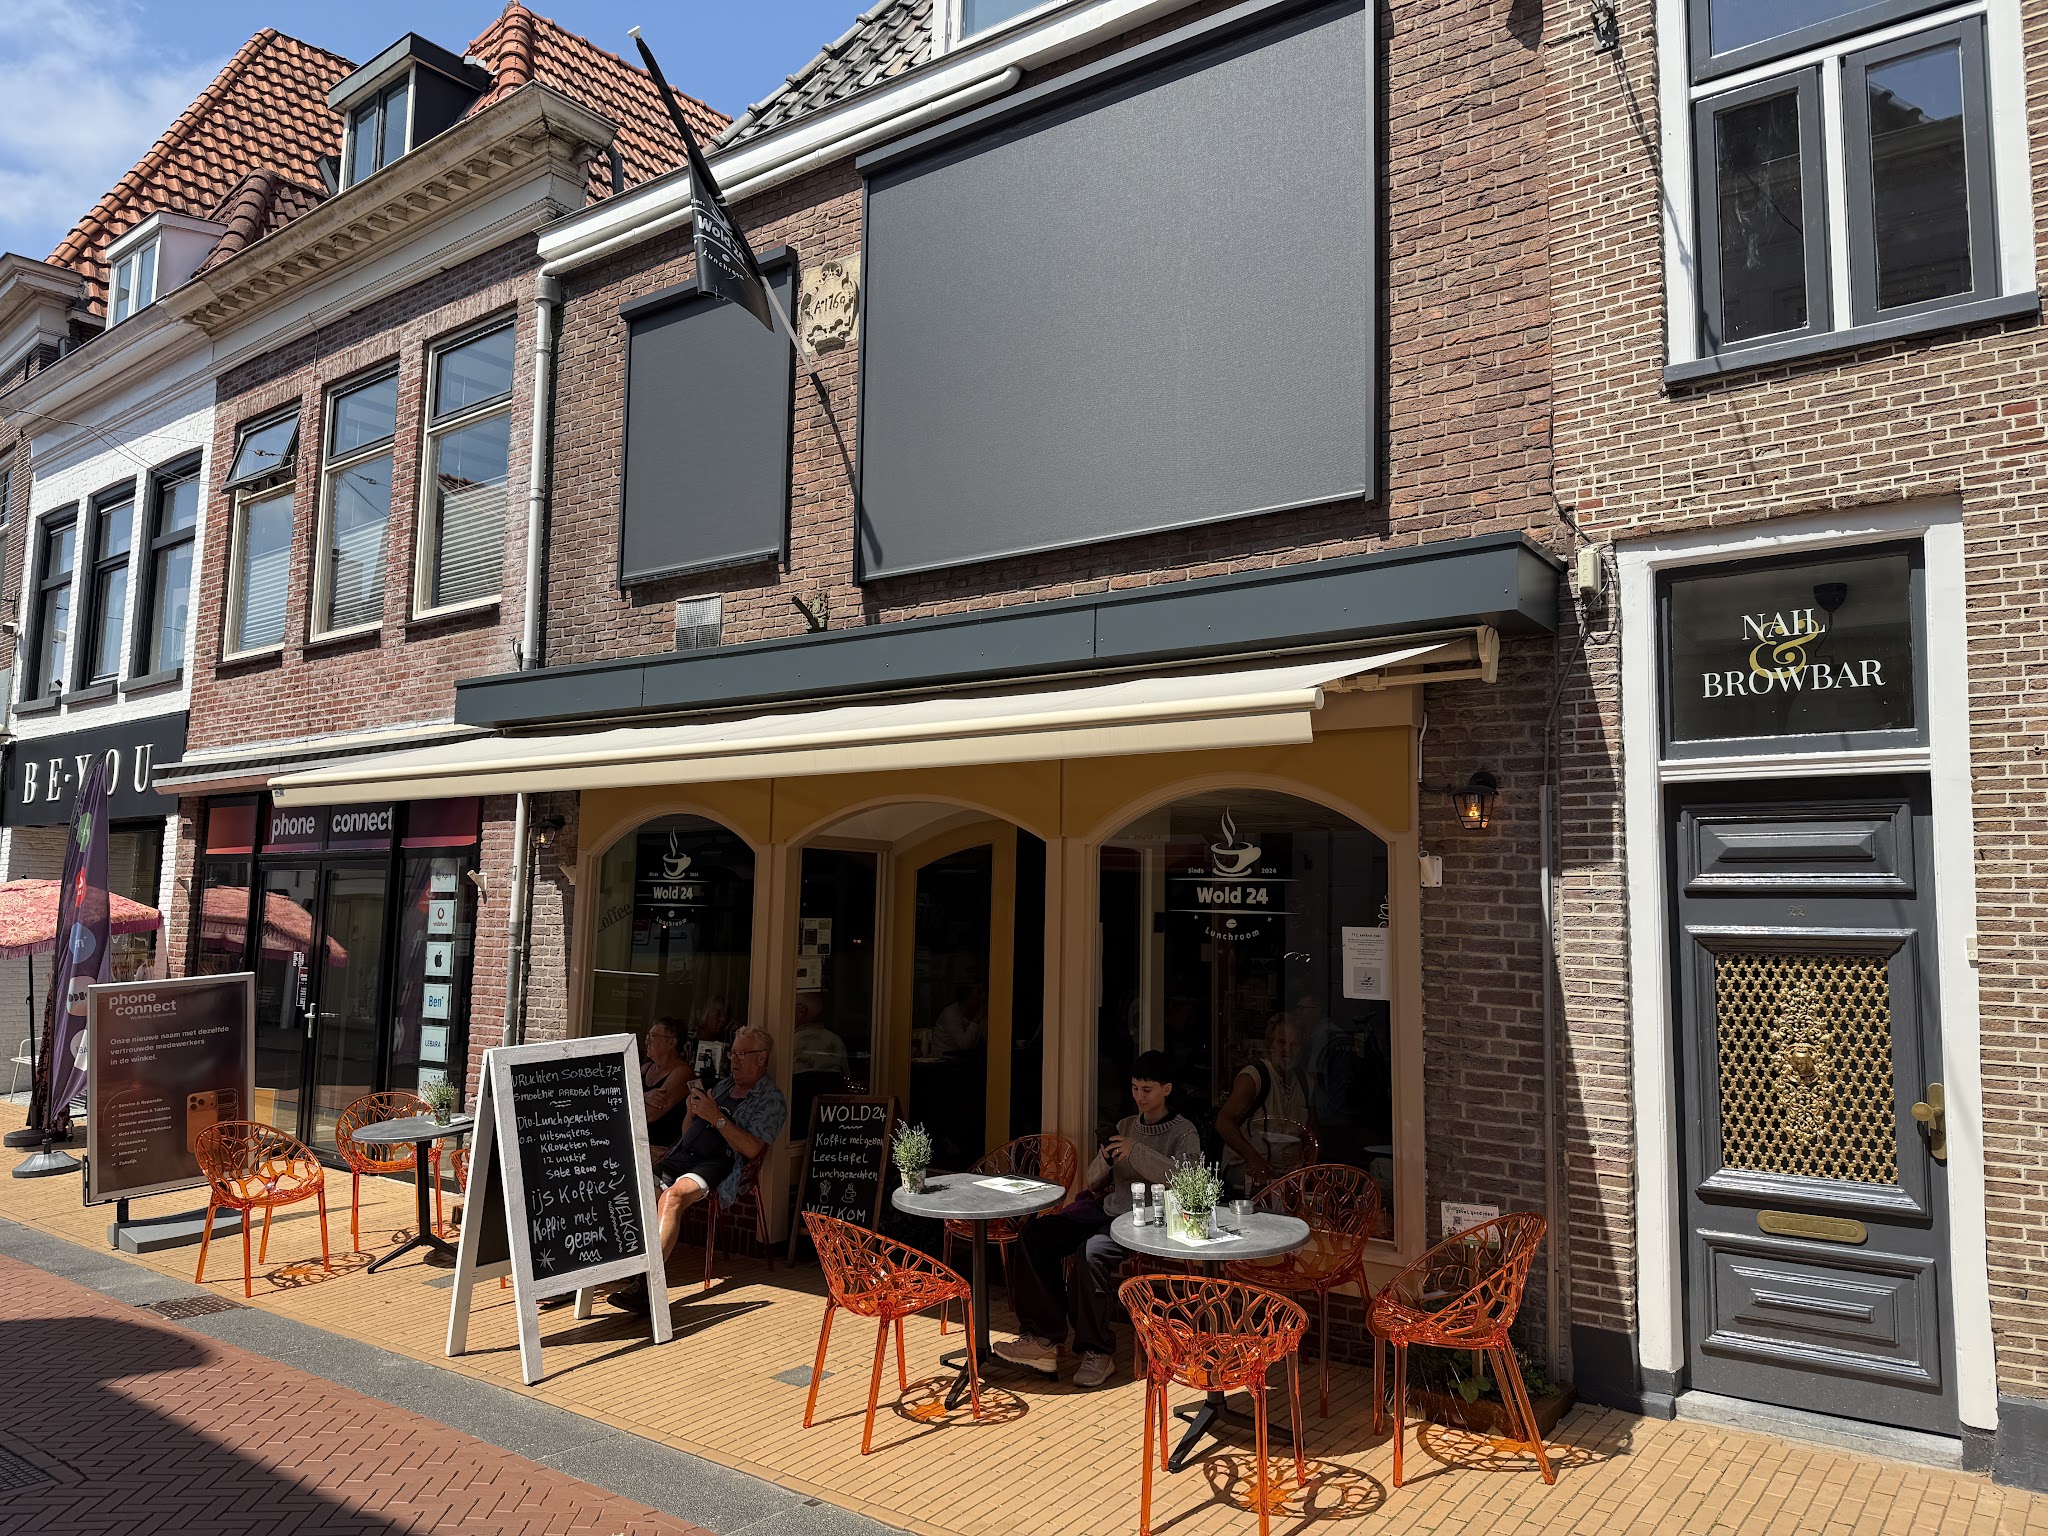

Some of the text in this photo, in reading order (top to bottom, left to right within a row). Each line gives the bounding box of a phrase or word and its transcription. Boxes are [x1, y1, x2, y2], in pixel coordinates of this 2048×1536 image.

[698, 215, 732, 249] Wold
[1741, 608, 1826, 641] NAIL
[1749, 619, 1820, 679] &
[1702, 659, 1887, 699] BROWBAR
[270, 806, 393, 844] phone connect
[653, 886, 694, 900] Wold 24
[1196, 886, 1269, 905] Wold 24
[1204, 926, 1260, 940] Lunchroom
[109, 992, 157, 1009] phone
[115, 999, 177, 1016] connect
[132, 1034, 158, 1042] nieuwe
[160, 1031, 180, 1040] naam
[197, 1025, 230, 1036] dezelfde
[110, 1038, 206, 1054] vertrouwde medewerkers
[110, 1057, 118, 1066] in
[119, 1056, 128, 1064] de
[815, 1132, 846, 1146] Koffie
[558, 1180, 609, 1204] Koffie
[532, 1206, 599, 1245] Koffie met
[612, 1190, 640, 1253] WELKOM
